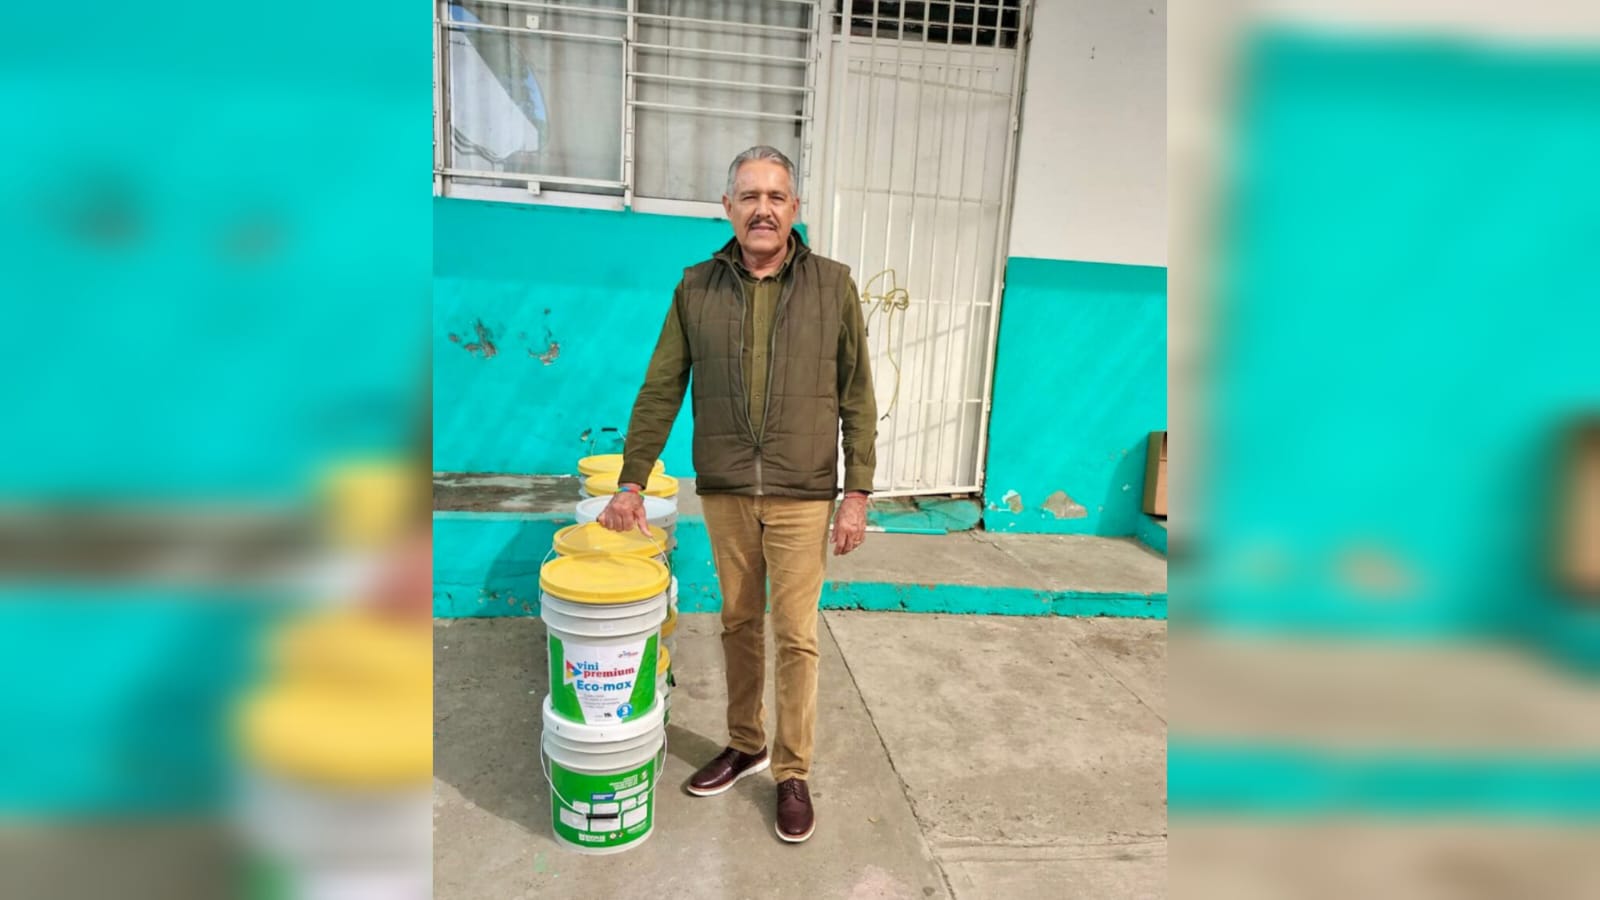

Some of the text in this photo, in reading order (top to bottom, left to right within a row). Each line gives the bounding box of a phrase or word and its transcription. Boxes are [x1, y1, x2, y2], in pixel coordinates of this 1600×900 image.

[576, 660, 599, 671] vini
[583, 667, 635, 679] premium
[577, 680, 632, 691] Eco-max
